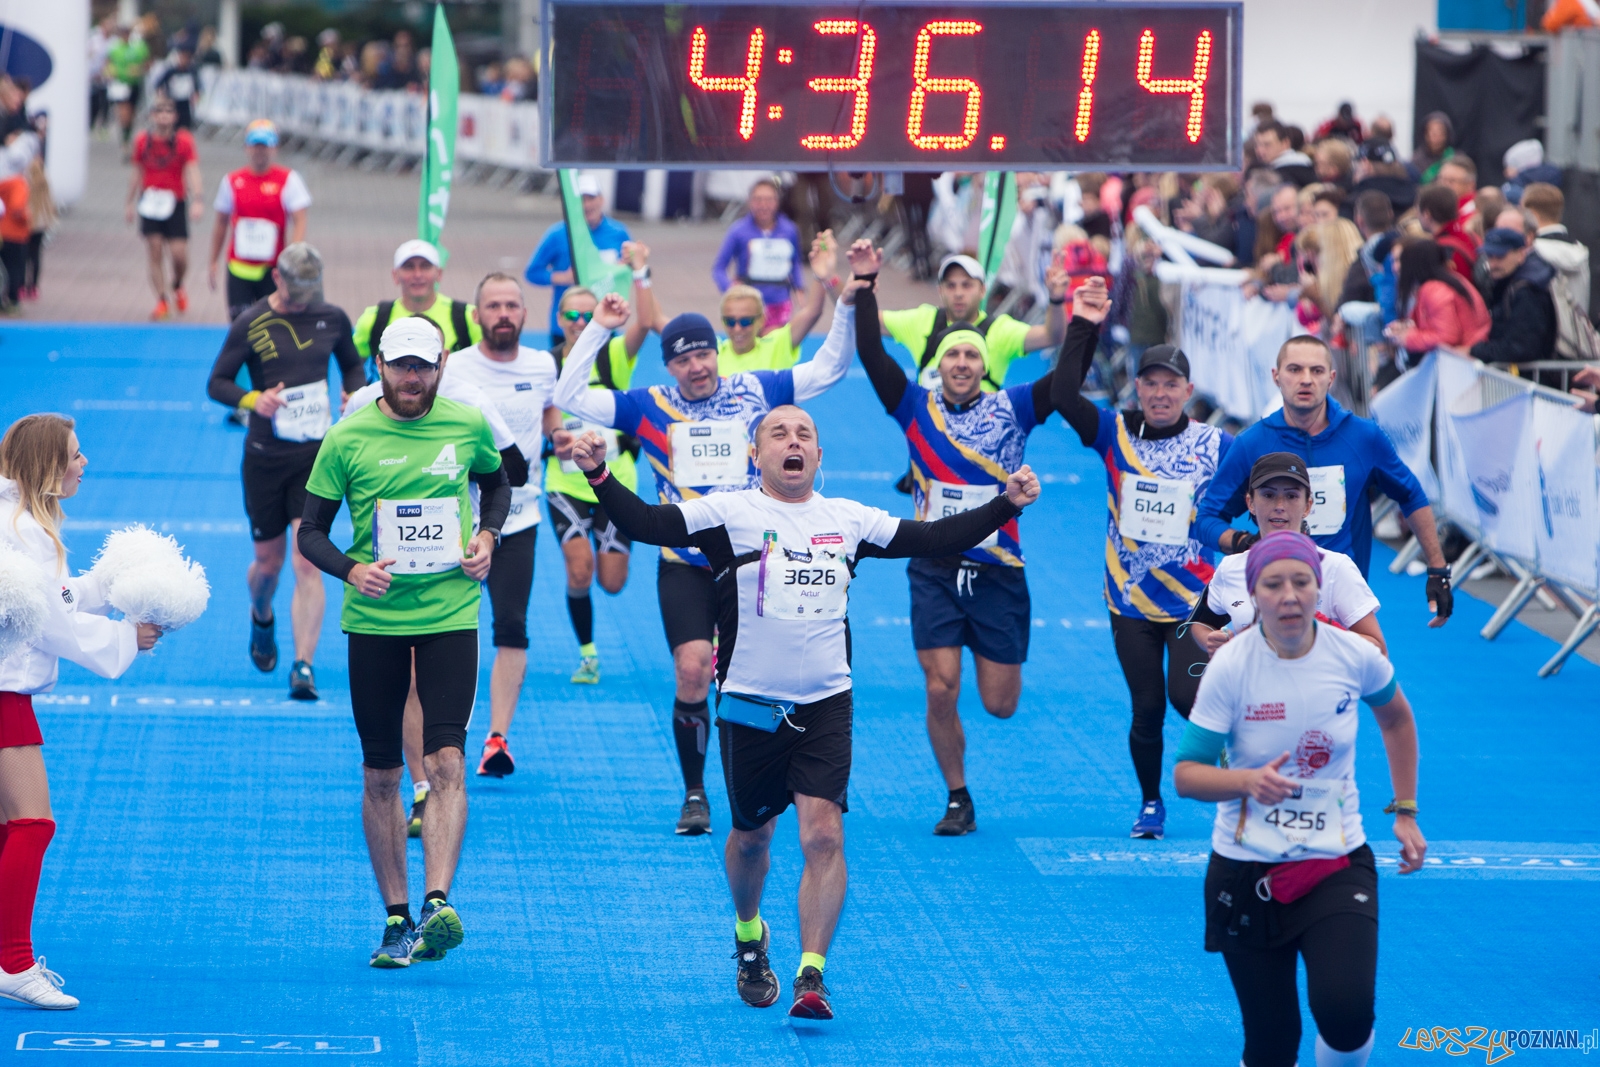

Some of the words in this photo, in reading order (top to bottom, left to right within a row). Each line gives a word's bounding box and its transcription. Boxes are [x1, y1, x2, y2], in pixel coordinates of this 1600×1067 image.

[691, 443, 731, 457] 6138
[1135, 498, 1175, 515] 6144
[397, 525, 443, 541] 1242
[397, 544, 444, 553] Przemysław
[784, 569, 836, 586] 3626
[800, 590, 820, 598] Artur
[1264, 808, 1327, 831] 4256
